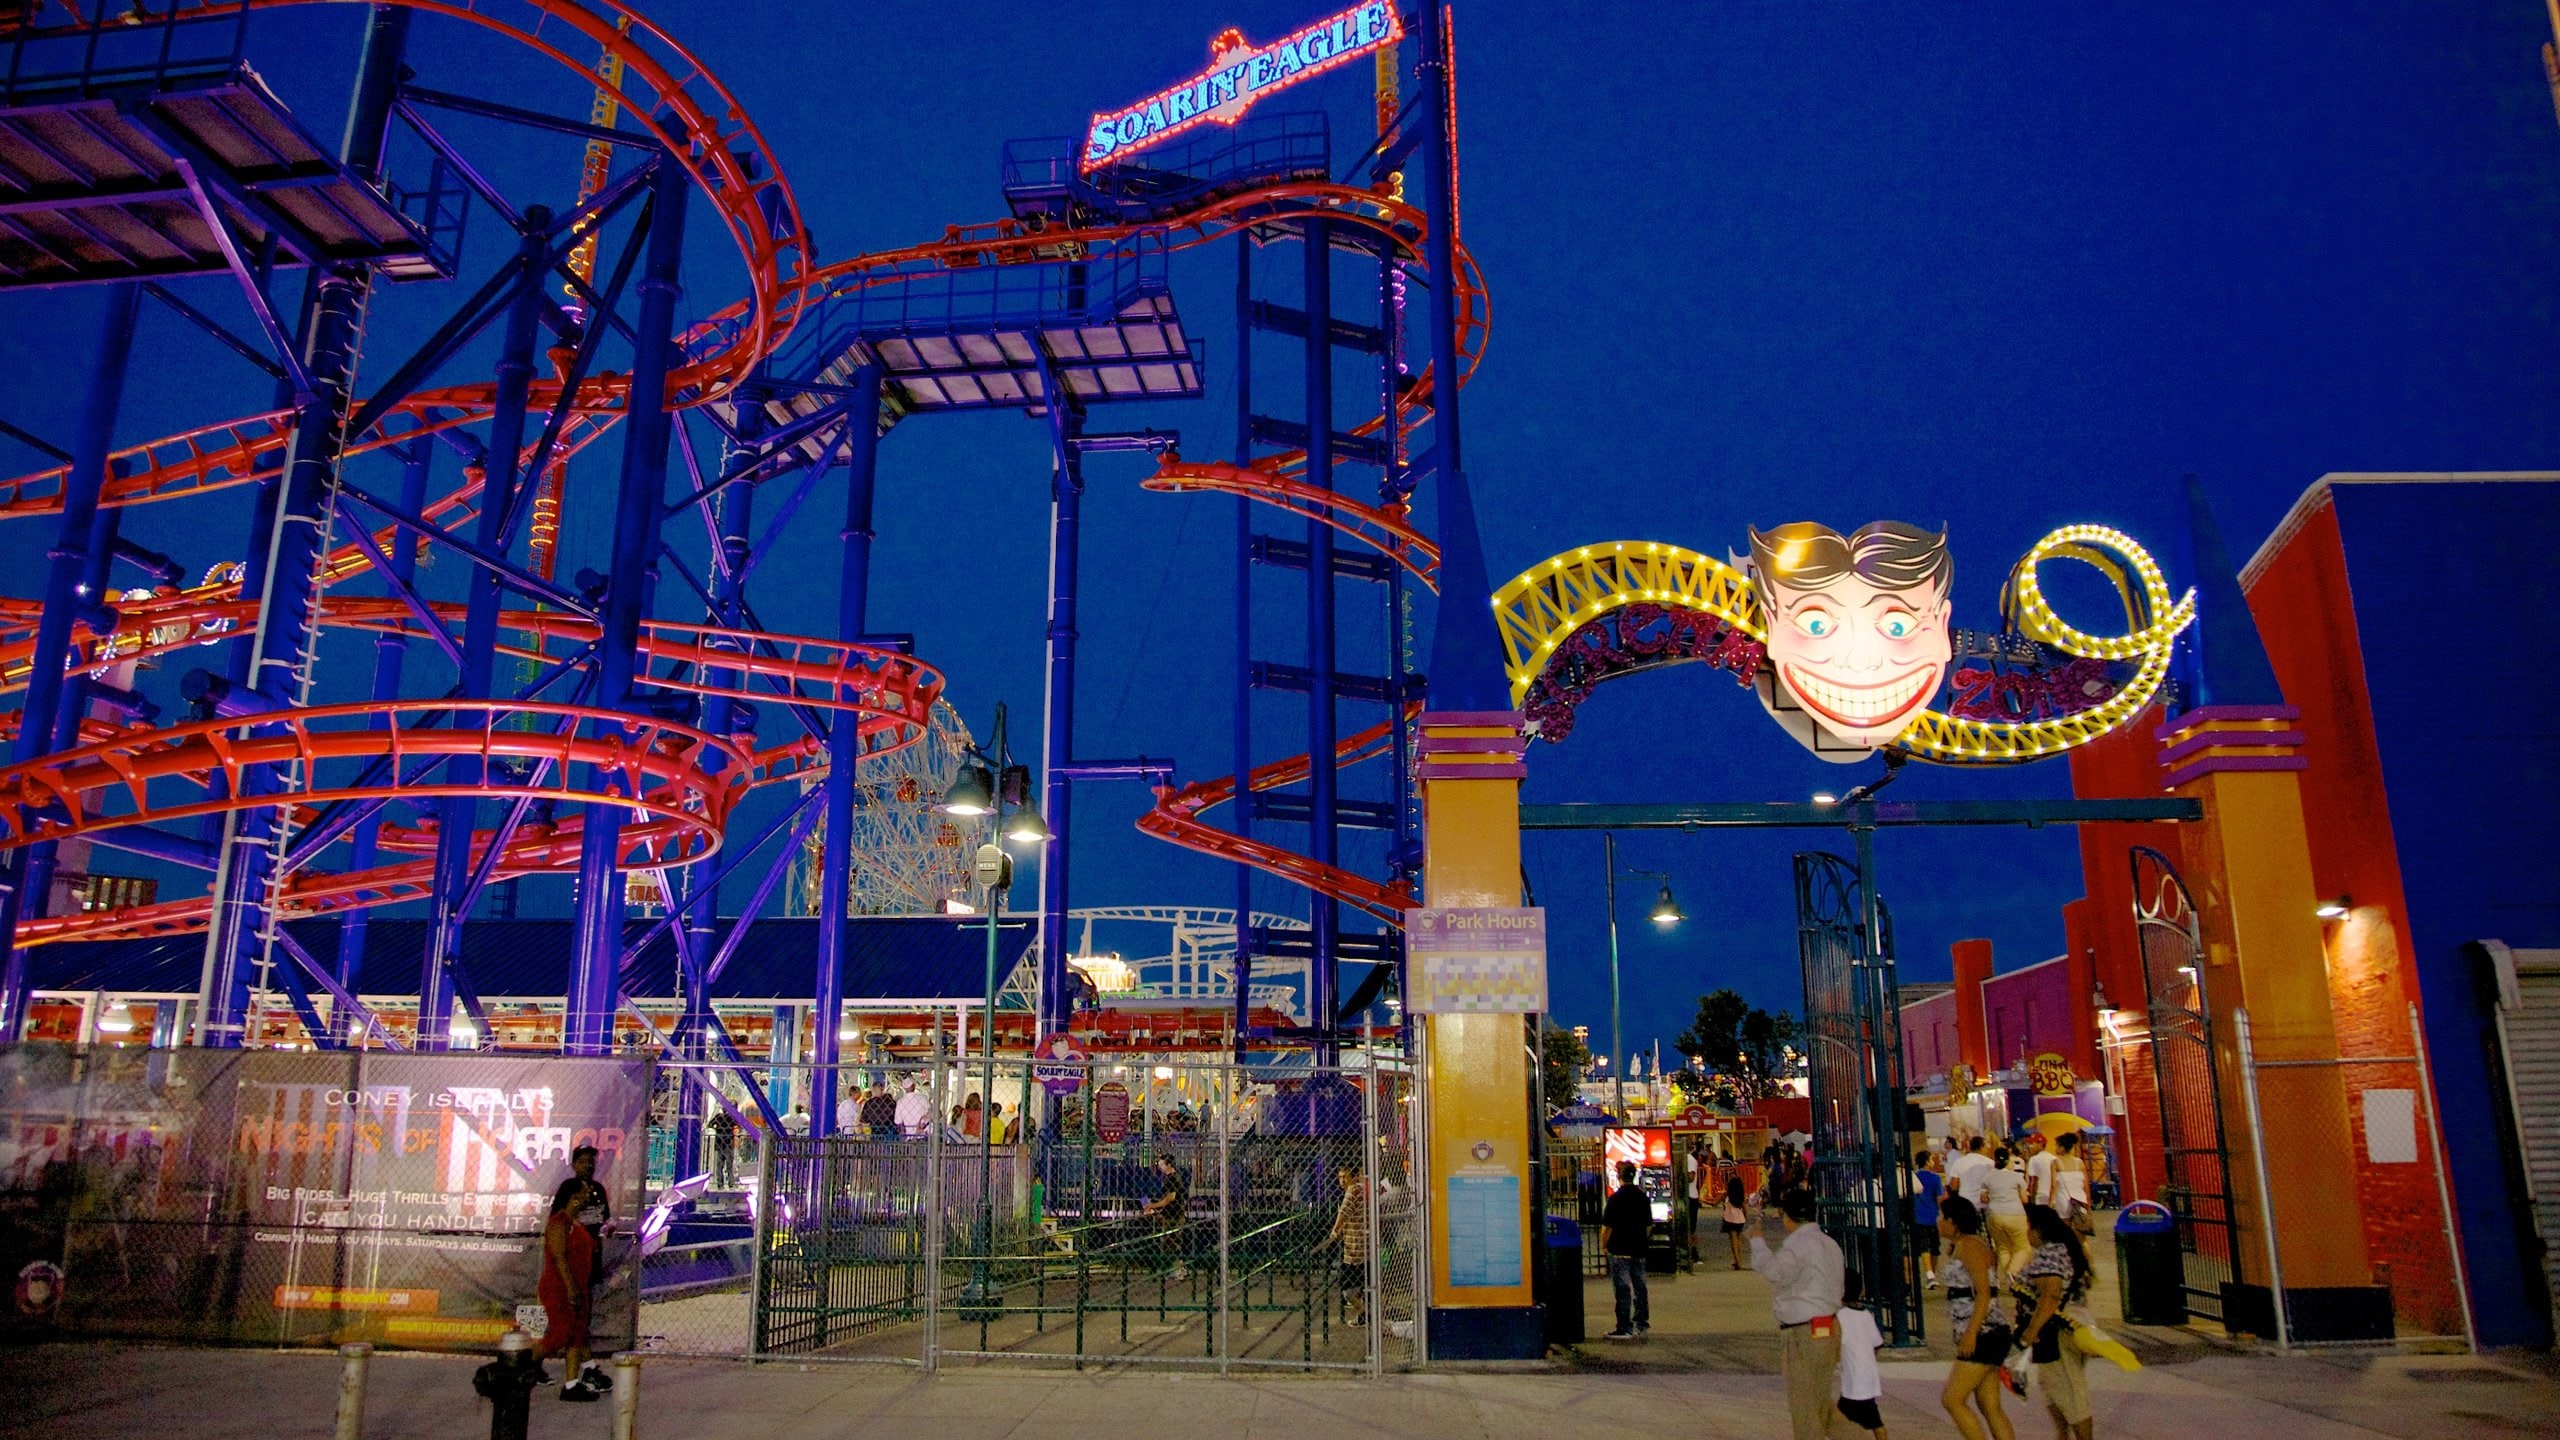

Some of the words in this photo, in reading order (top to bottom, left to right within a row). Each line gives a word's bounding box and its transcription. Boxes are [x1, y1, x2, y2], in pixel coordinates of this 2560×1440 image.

[1247, 1, 1391, 91] EAGLE
[1446, 913, 1484, 929] Park
[1487, 914, 1538, 929] Hours
[2031, 1072, 2076, 1093] BBQ
[324, 1088, 418, 1108] CONEY
[403, 1127, 438, 1154] OF
[357, 1213, 397, 1227] YOU
[407, 1214, 495, 1230] HANDLE
